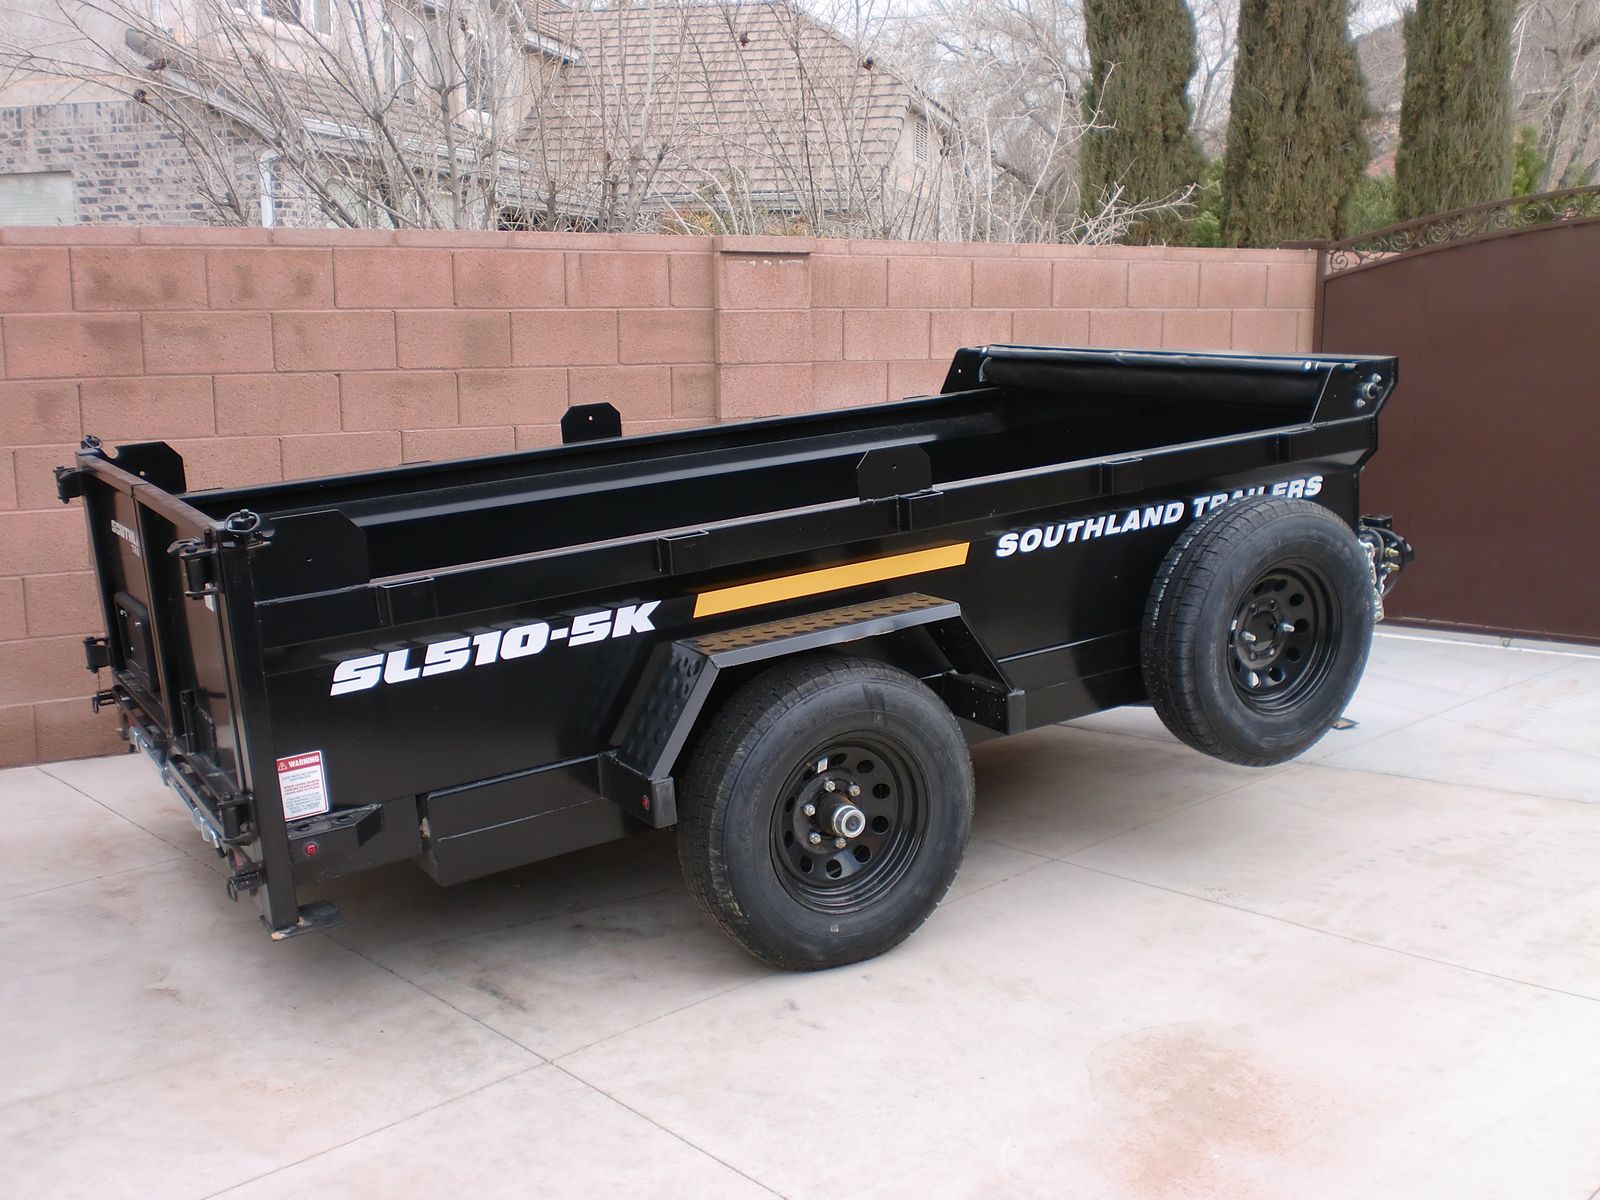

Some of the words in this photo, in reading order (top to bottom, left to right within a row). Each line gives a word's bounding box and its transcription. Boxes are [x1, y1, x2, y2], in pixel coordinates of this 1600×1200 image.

[996, 501, 1185, 557] SOUTHLAND
[329, 600, 662, 696] SL510-5K
[288, 755, 320, 768] WARNING
